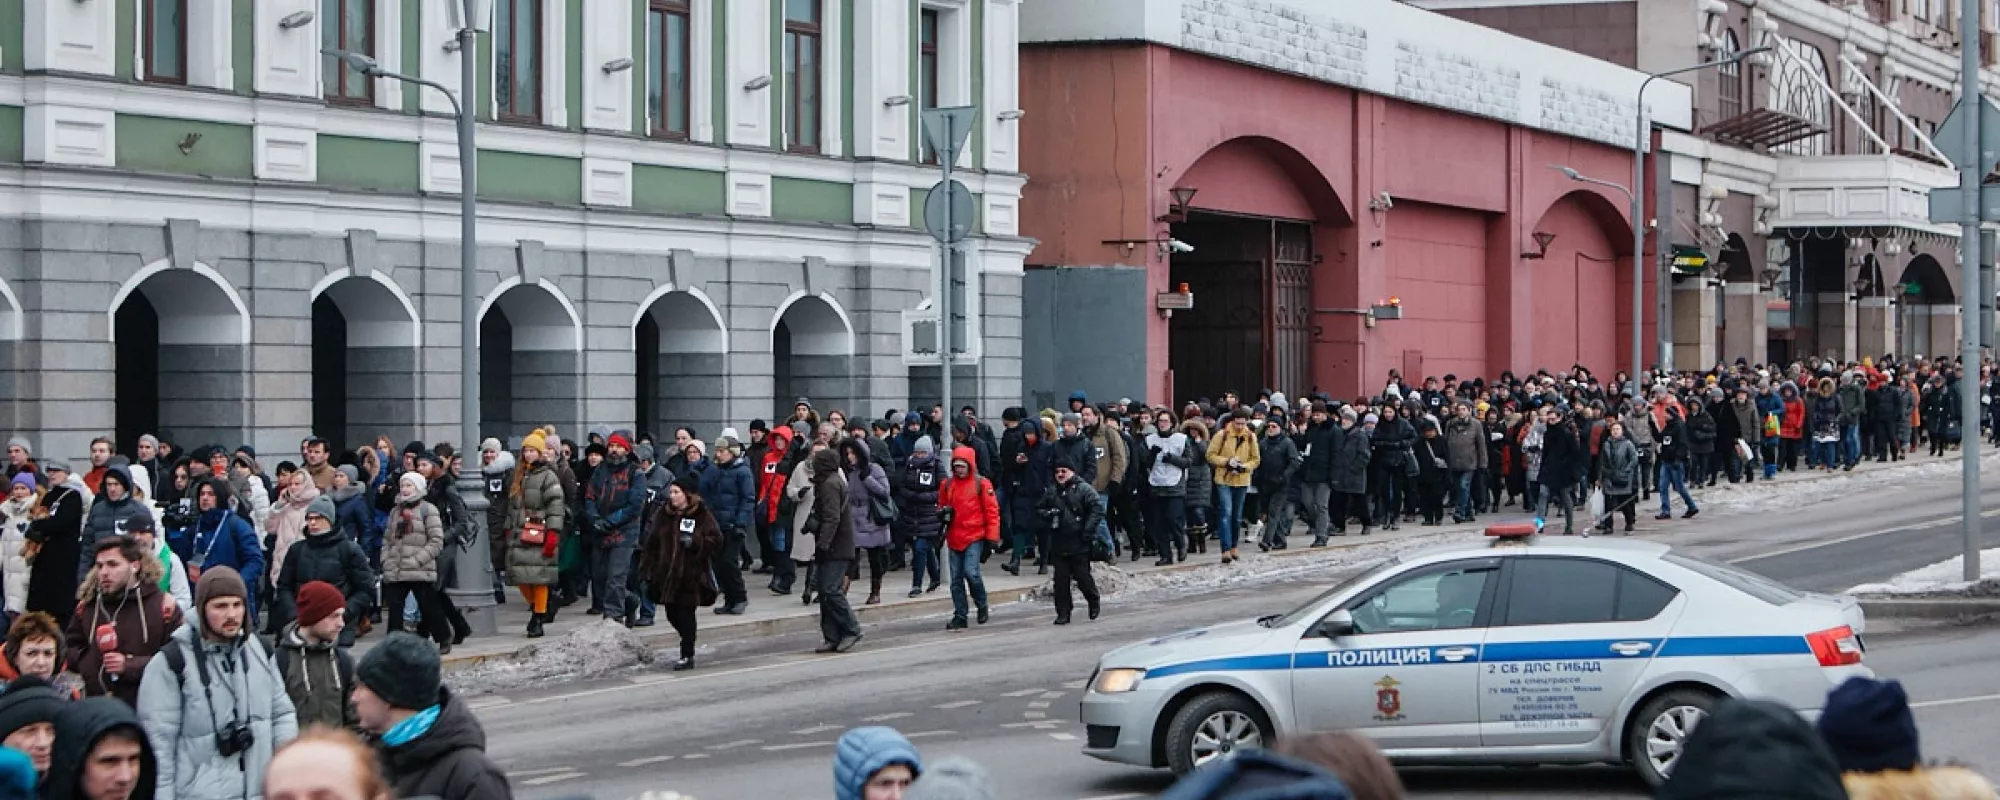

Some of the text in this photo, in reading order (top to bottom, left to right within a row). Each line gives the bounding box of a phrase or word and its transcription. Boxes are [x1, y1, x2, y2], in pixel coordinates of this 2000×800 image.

[1327, 648, 1431, 666] ПОЛИЦИЯ
[1488, 661, 1602, 675] 2 СБ ДПС ГИБДД
